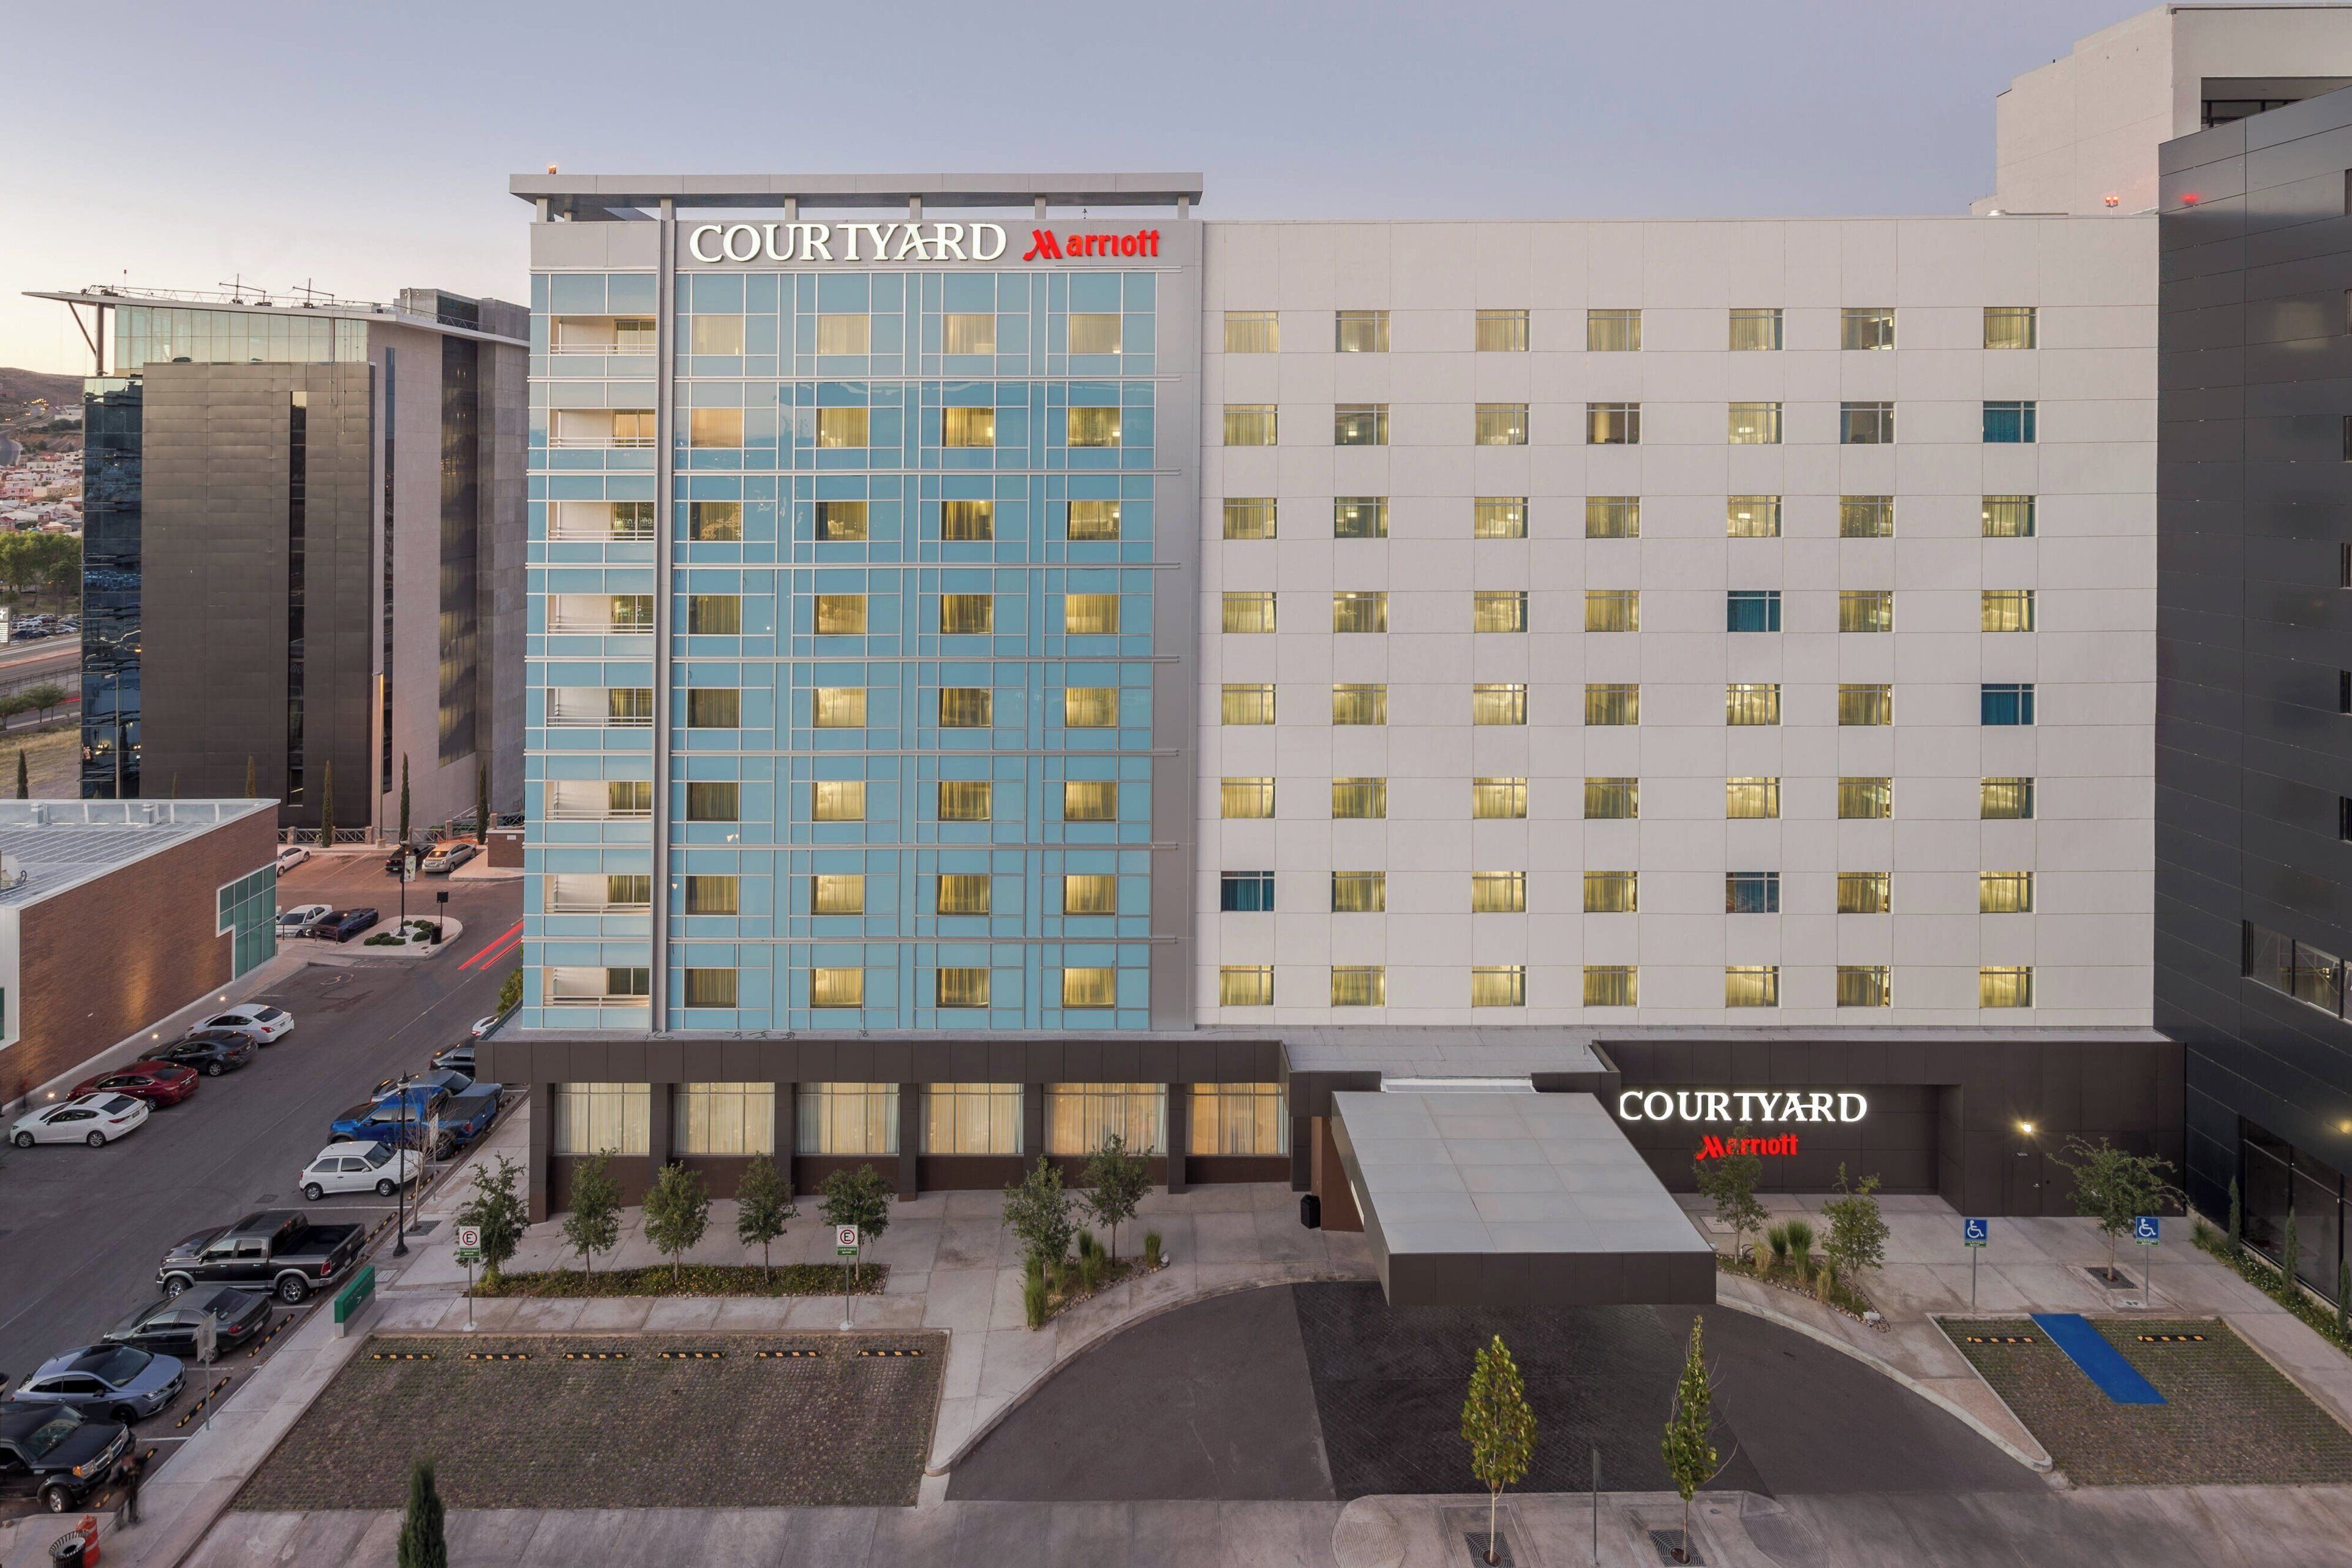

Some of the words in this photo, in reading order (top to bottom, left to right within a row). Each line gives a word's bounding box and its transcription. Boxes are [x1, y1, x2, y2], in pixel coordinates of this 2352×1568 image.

[689, 223, 1007, 263] COURTYARD
[1022, 228, 1160, 262] Marriott
[1619, 1090, 1868, 1123] COURTYARD
[1695, 1133, 1798, 1160] Marriott
[466, 1234, 473, 1243] E
[844, 1232, 851, 1242] E
